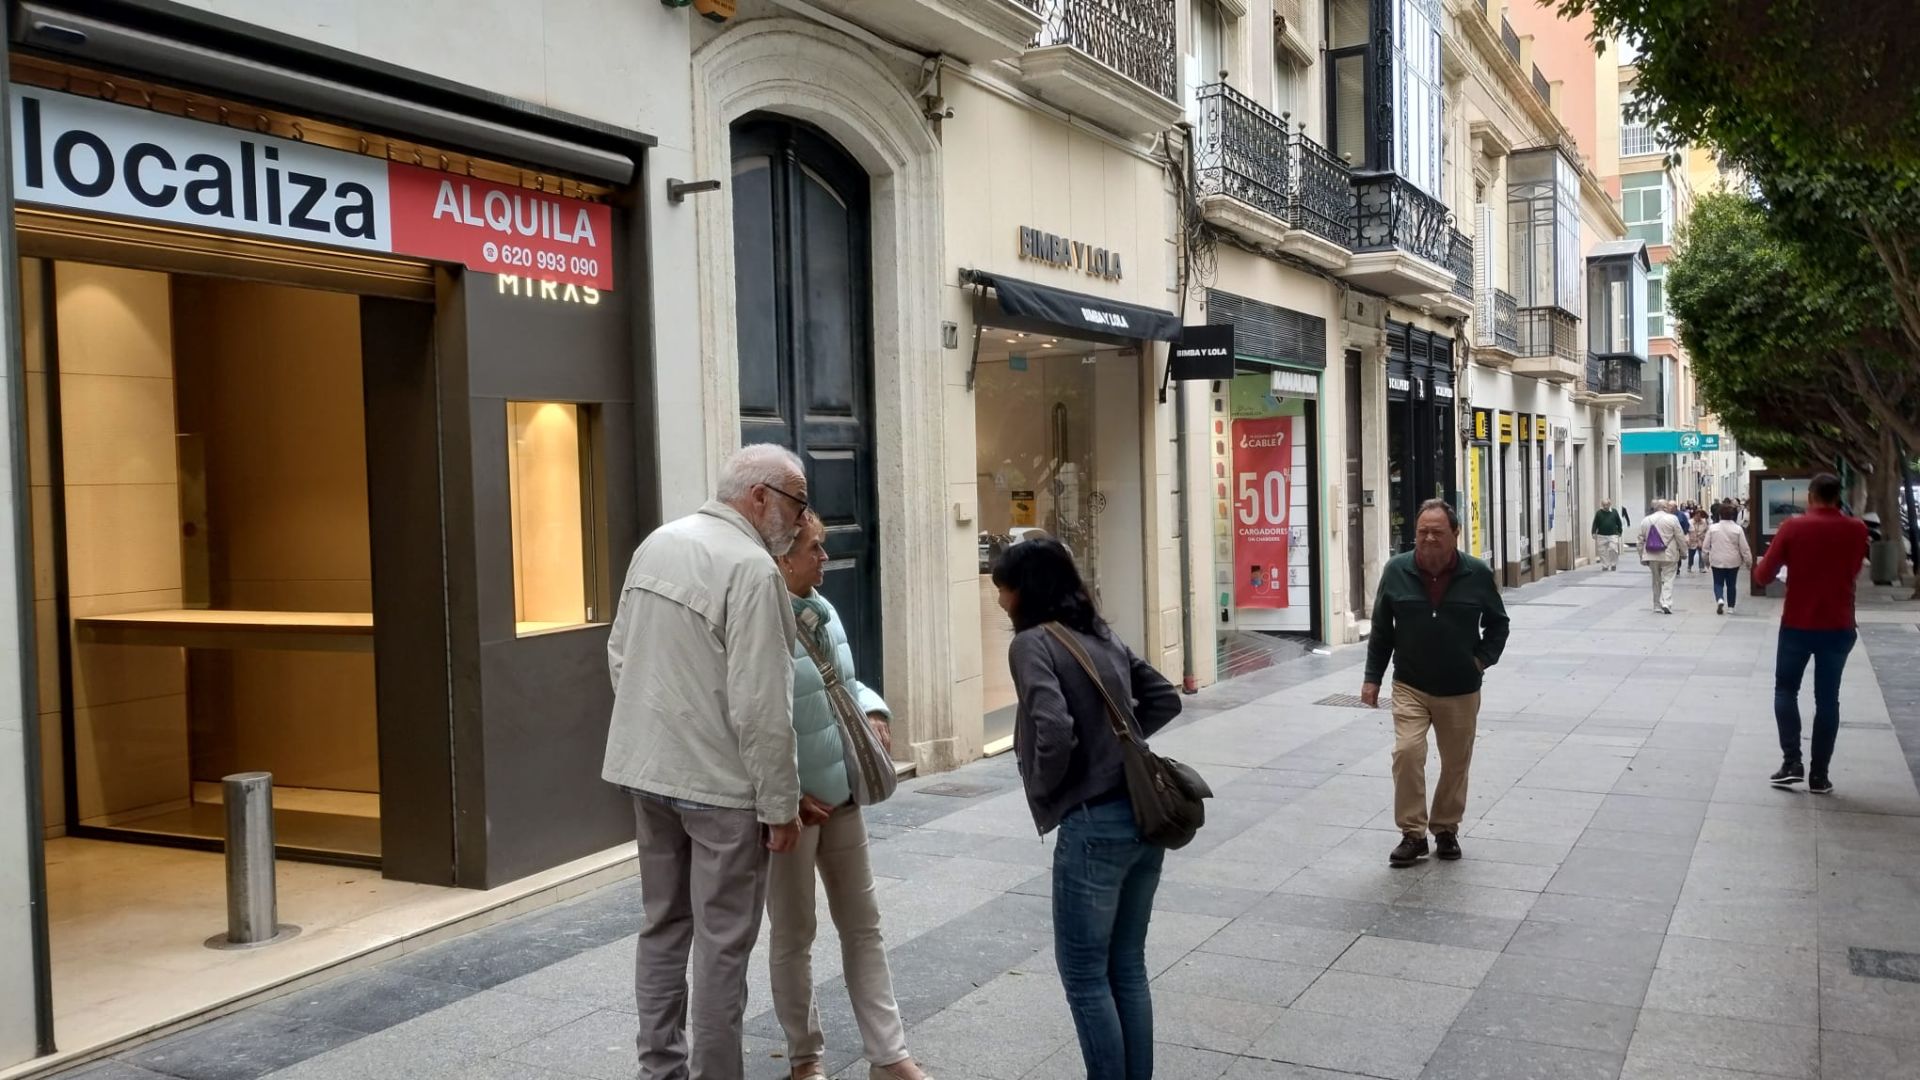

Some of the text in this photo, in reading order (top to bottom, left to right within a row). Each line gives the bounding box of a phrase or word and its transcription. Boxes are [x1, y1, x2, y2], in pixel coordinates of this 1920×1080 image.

[22, 96, 376, 240] localiza
[433, 180, 596, 247] ALQUILA
[502, 245, 598, 277] 620 993 090
[1017, 225, 1122, 280] BIMBA Y LOLA
[499, 273, 600, 305] MIRAS
[1081, 307, 1105, 324] BIMBA
[1110, 312, 1129, 328] LOLA
[1177, 348, 1227, 357] BIMBA Y LOLA
[1683, 436, 1696, 447] 24
[1239, 528, 1288, 536] CARGADORES
